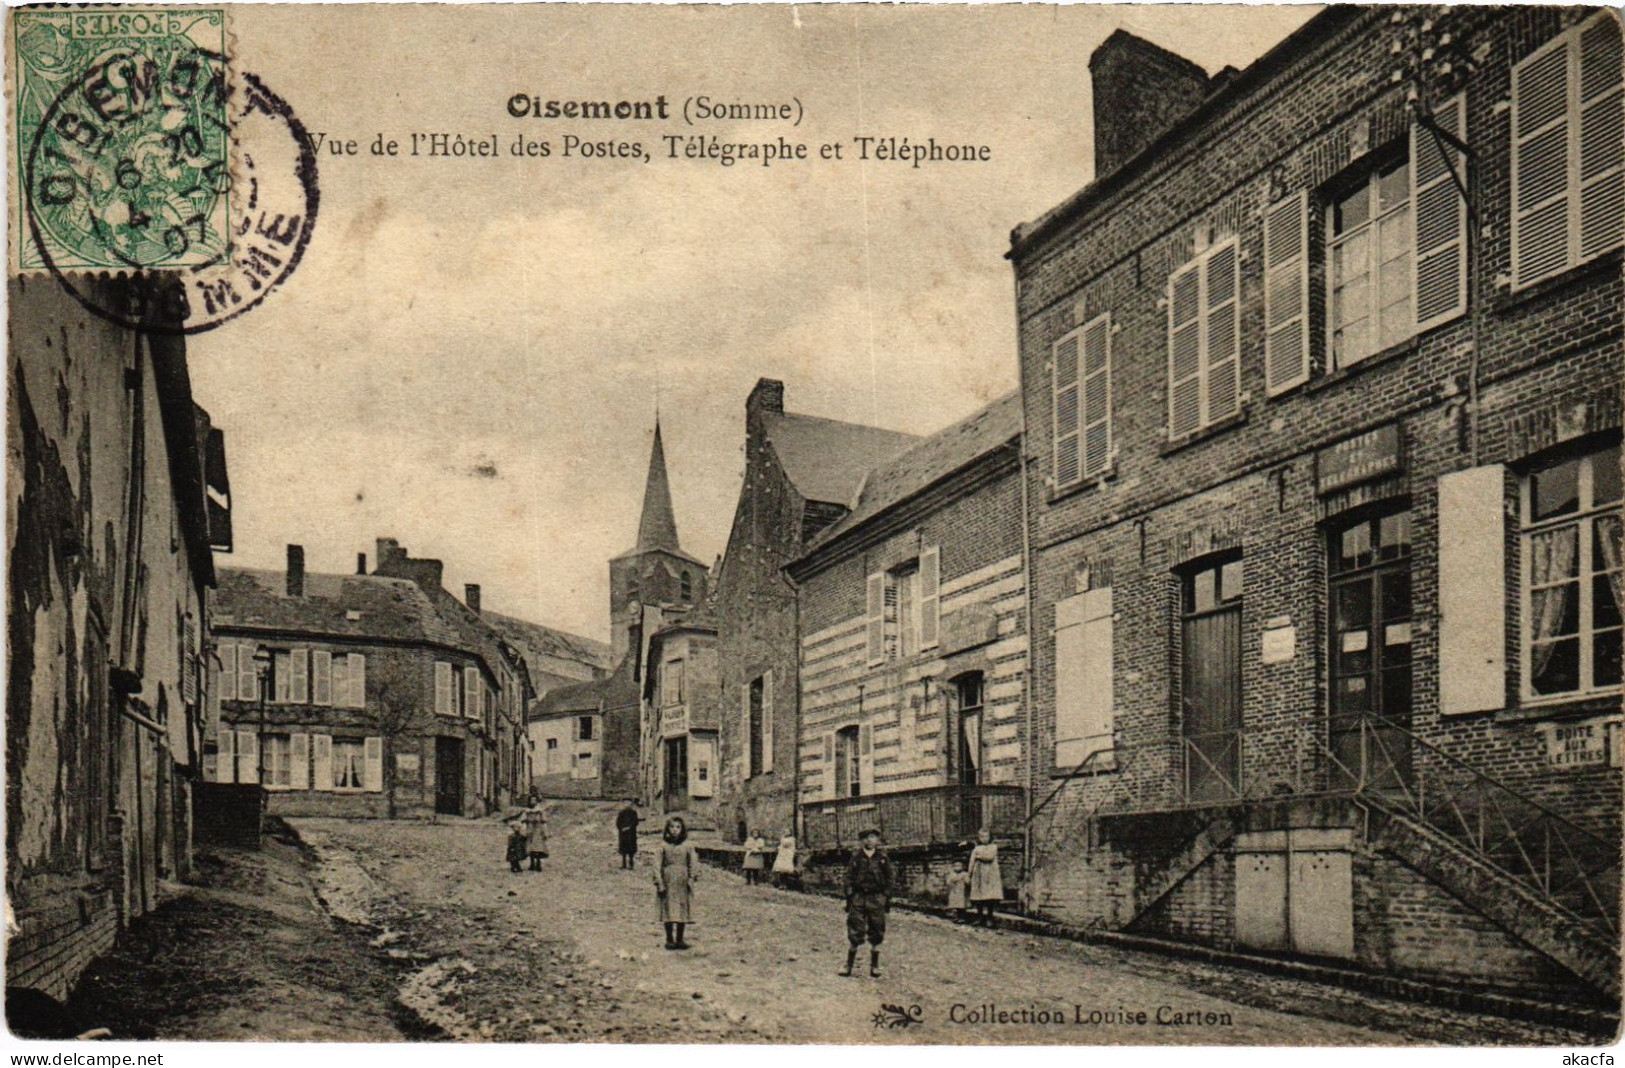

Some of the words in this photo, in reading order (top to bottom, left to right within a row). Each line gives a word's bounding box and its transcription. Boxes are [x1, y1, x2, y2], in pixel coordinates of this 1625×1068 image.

[75, 14, 164, 38] POSTES
[1565, 739, 1587, 752] AUX
[1548, 749, 1604, 765] LETTRES
